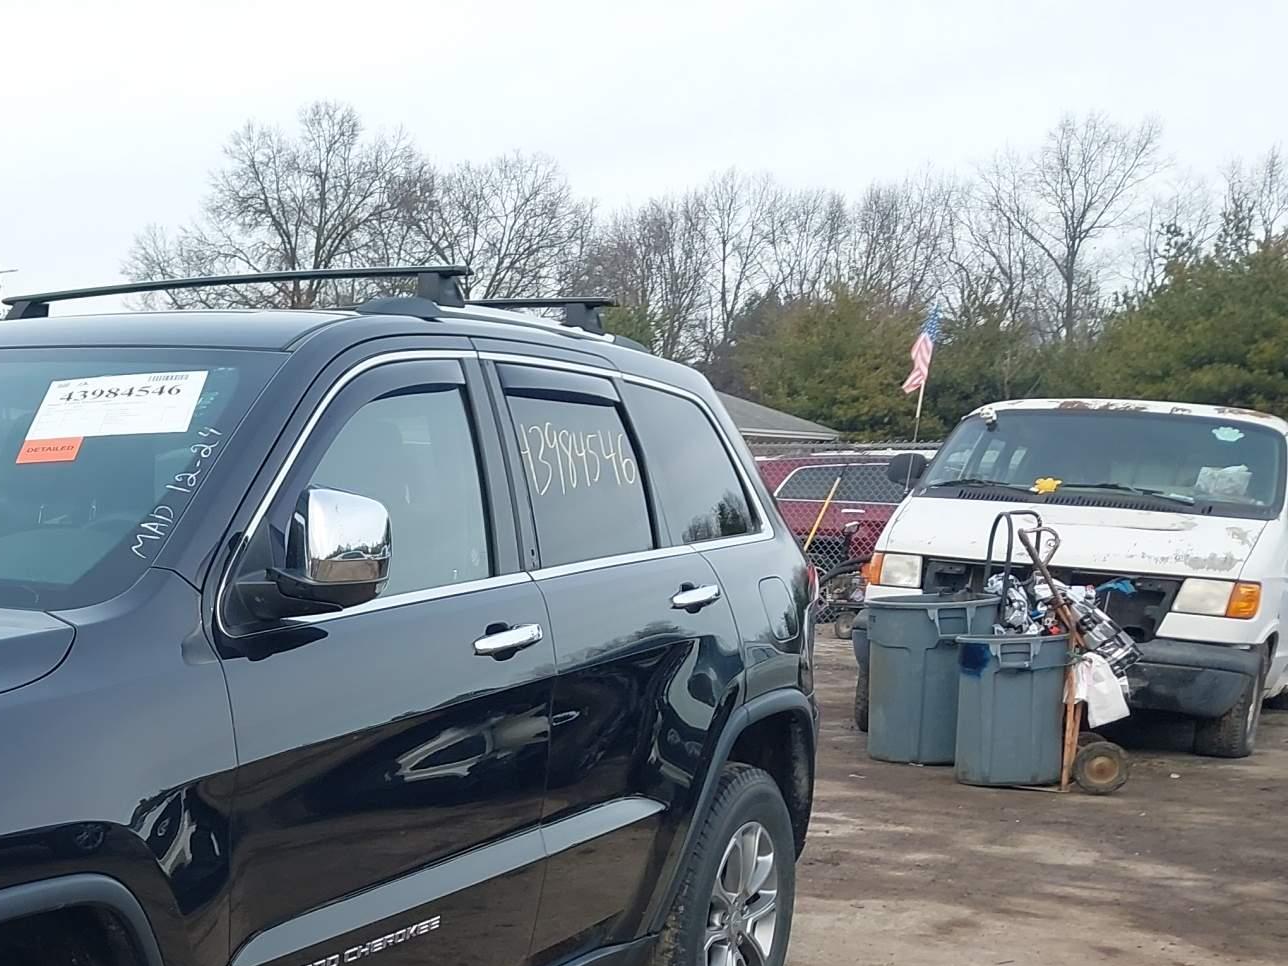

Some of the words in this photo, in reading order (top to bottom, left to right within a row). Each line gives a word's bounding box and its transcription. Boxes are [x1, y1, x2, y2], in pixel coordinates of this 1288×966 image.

[59, 384, 181, 402] 43984546
[26, 445, 74, 453] DETAILED
[520, 422, 636, 495] 43984546
[131, 505, 174, 559] MAD
[165, 426, 223, 493] 12-24
[343, 915, 441, 963] CHEROKEE
